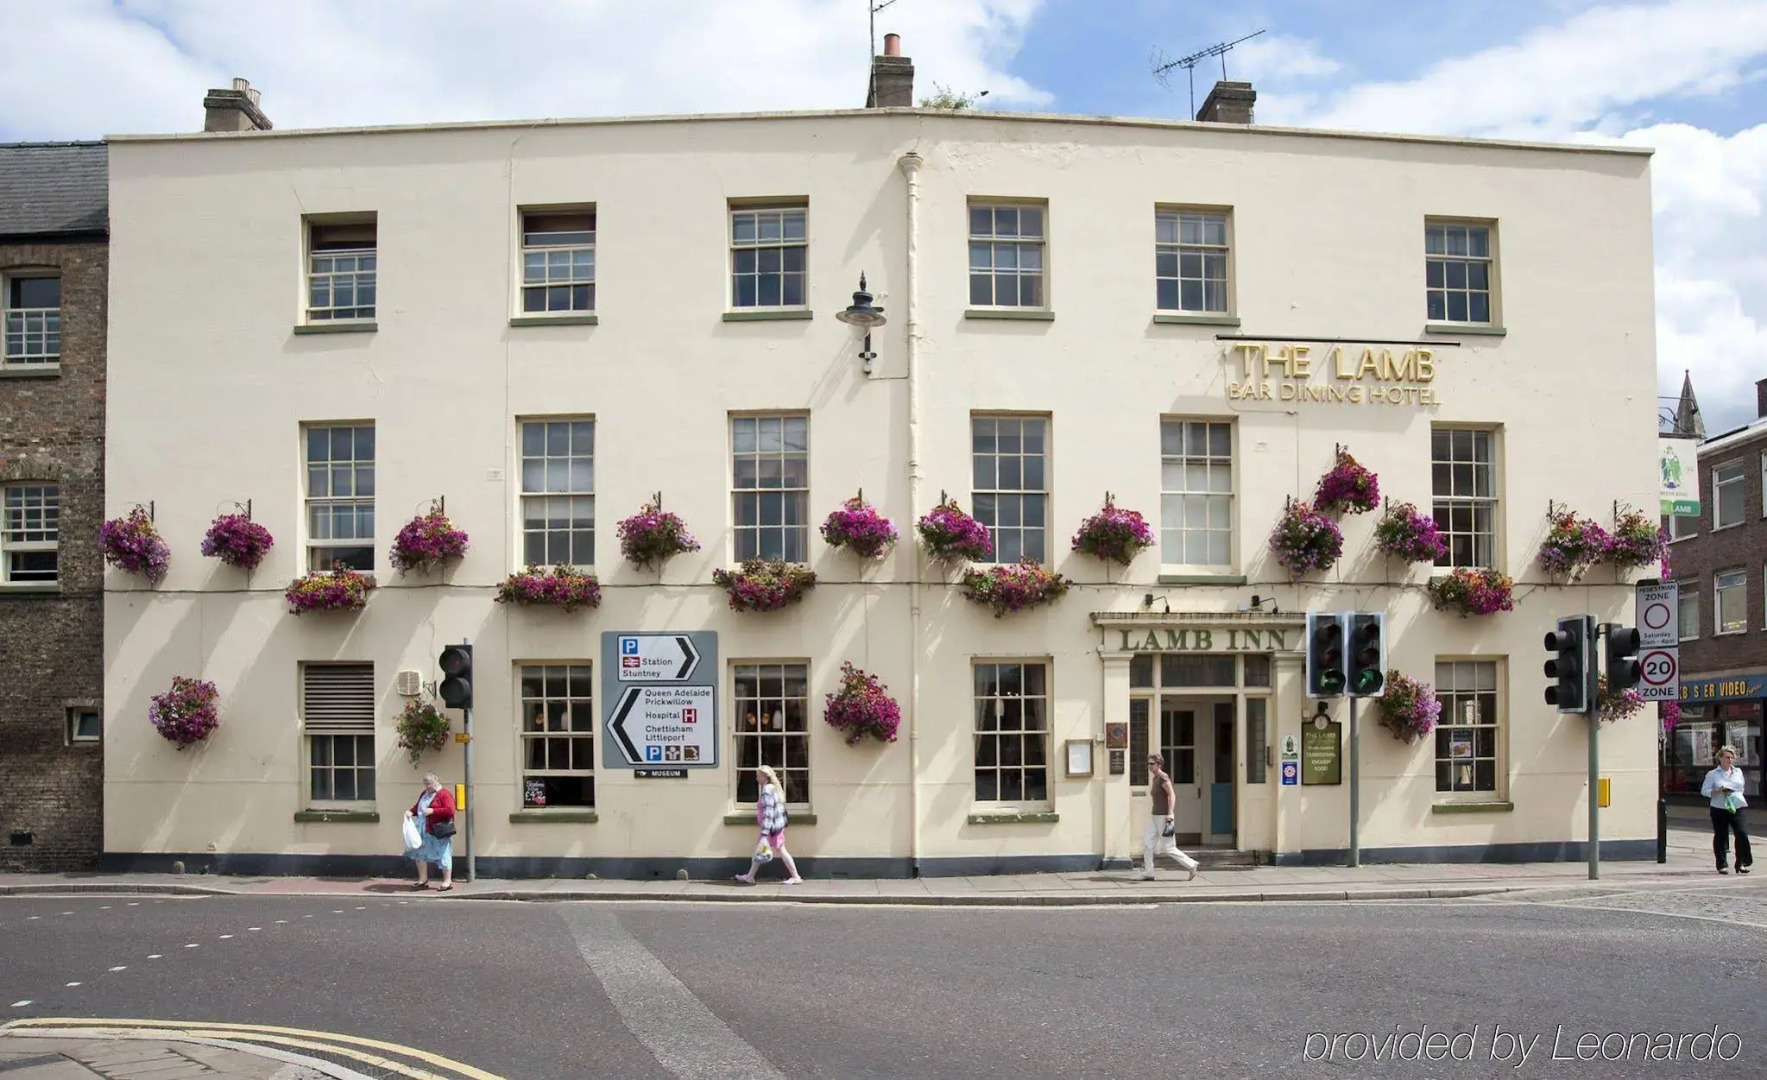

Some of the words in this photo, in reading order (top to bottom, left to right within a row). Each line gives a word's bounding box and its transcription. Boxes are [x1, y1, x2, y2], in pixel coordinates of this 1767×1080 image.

[1234, 343, 1311, 379] THE
[1335, 345, 1435, 382] LAMB
[1228, 382, 1272, 401] BAR
[1280, 384, 1364, 403] DINING
[1369, 386, 1444, 406] HOTEL
[1645, 591, 1669, 601] ZONE
[1117, 629, 1213, 651] LAMB
[1226, 629, 1288, 651] INN
[642, 658, 673, 666] Station
[1646, 661, 1671, 675] 20
[622, 670, 661, 678] Stuntney
[645, 689, 672, 697] Queen
[674, 689, 710, 697] Adelaide
[1642, 687, 1675, 697] ZONE
[1719, 681, 1746, 696] VIDEO
[645, 711, 680, 720] Hospital
[645, 725, 693, 733] Chettisham
[645, 734, 685, 742] Littleport
